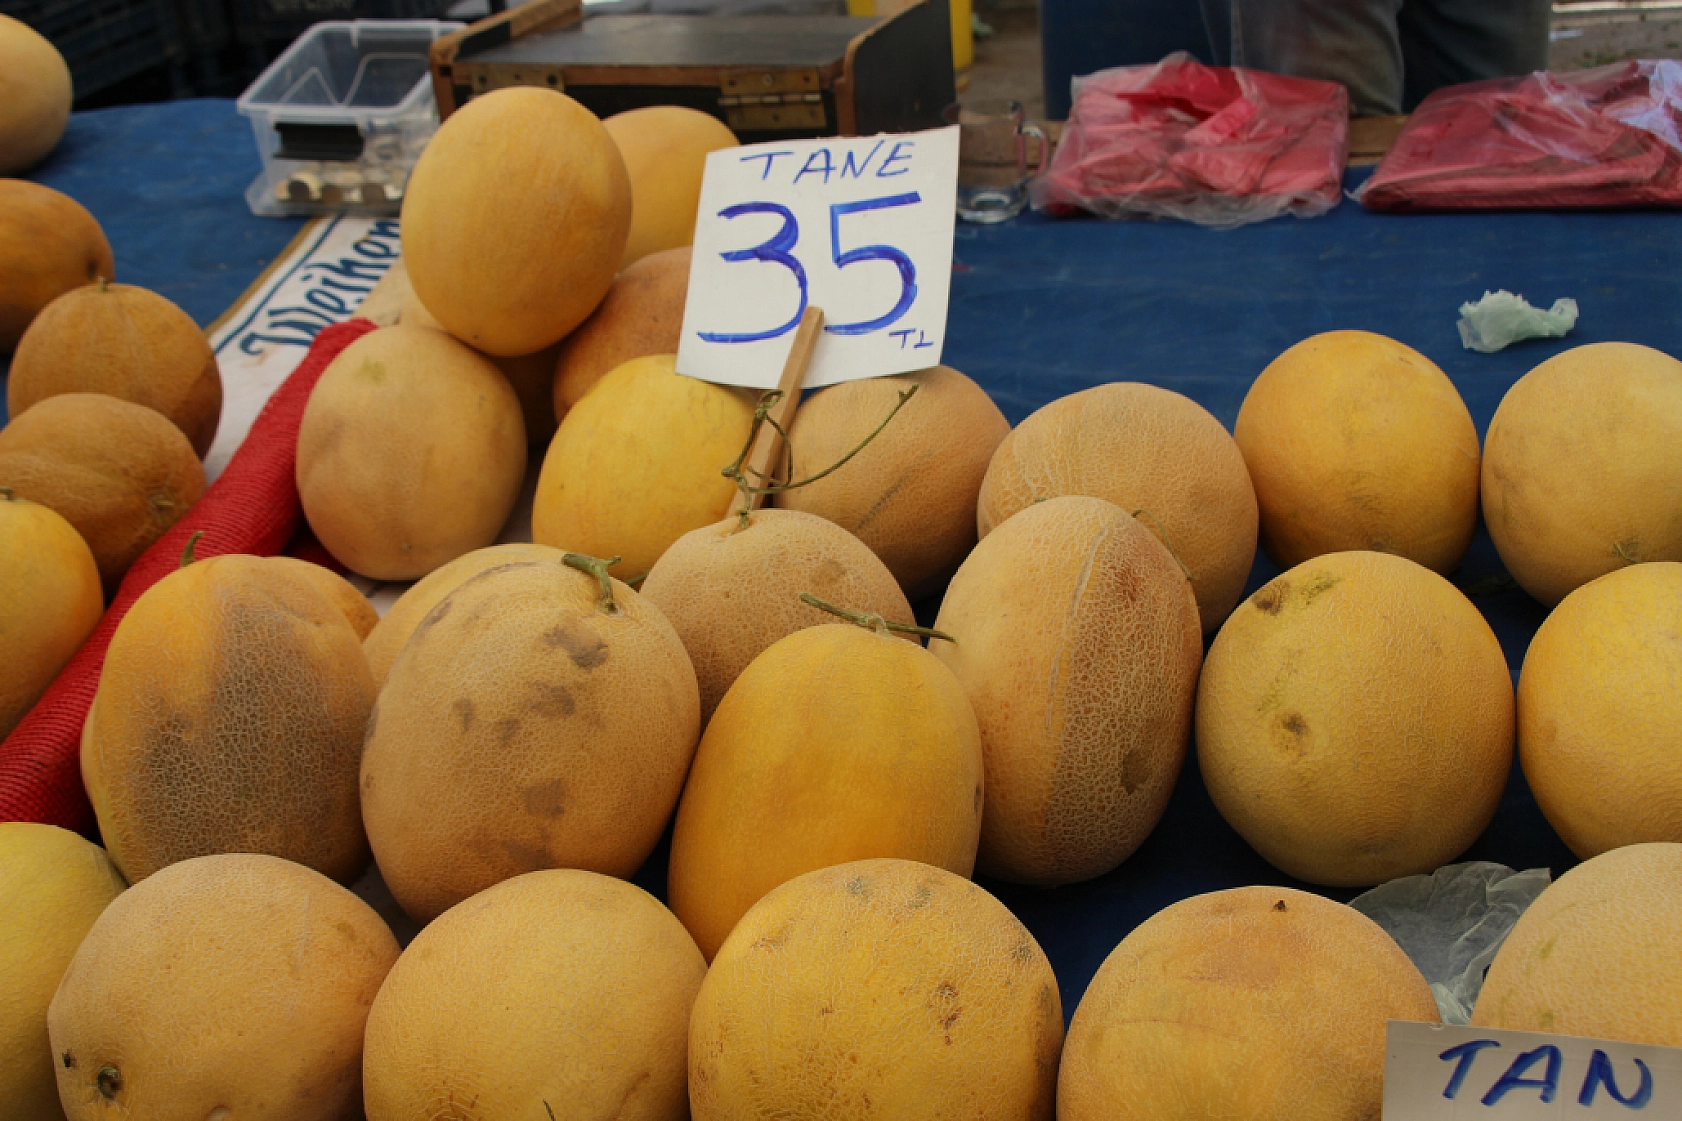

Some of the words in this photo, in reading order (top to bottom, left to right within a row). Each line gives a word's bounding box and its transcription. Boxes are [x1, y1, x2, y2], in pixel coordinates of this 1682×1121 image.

[739, 139, 916, 185] TANE
[697, 191, 922, 344] 35
[888, 328, 934, 349] TL
